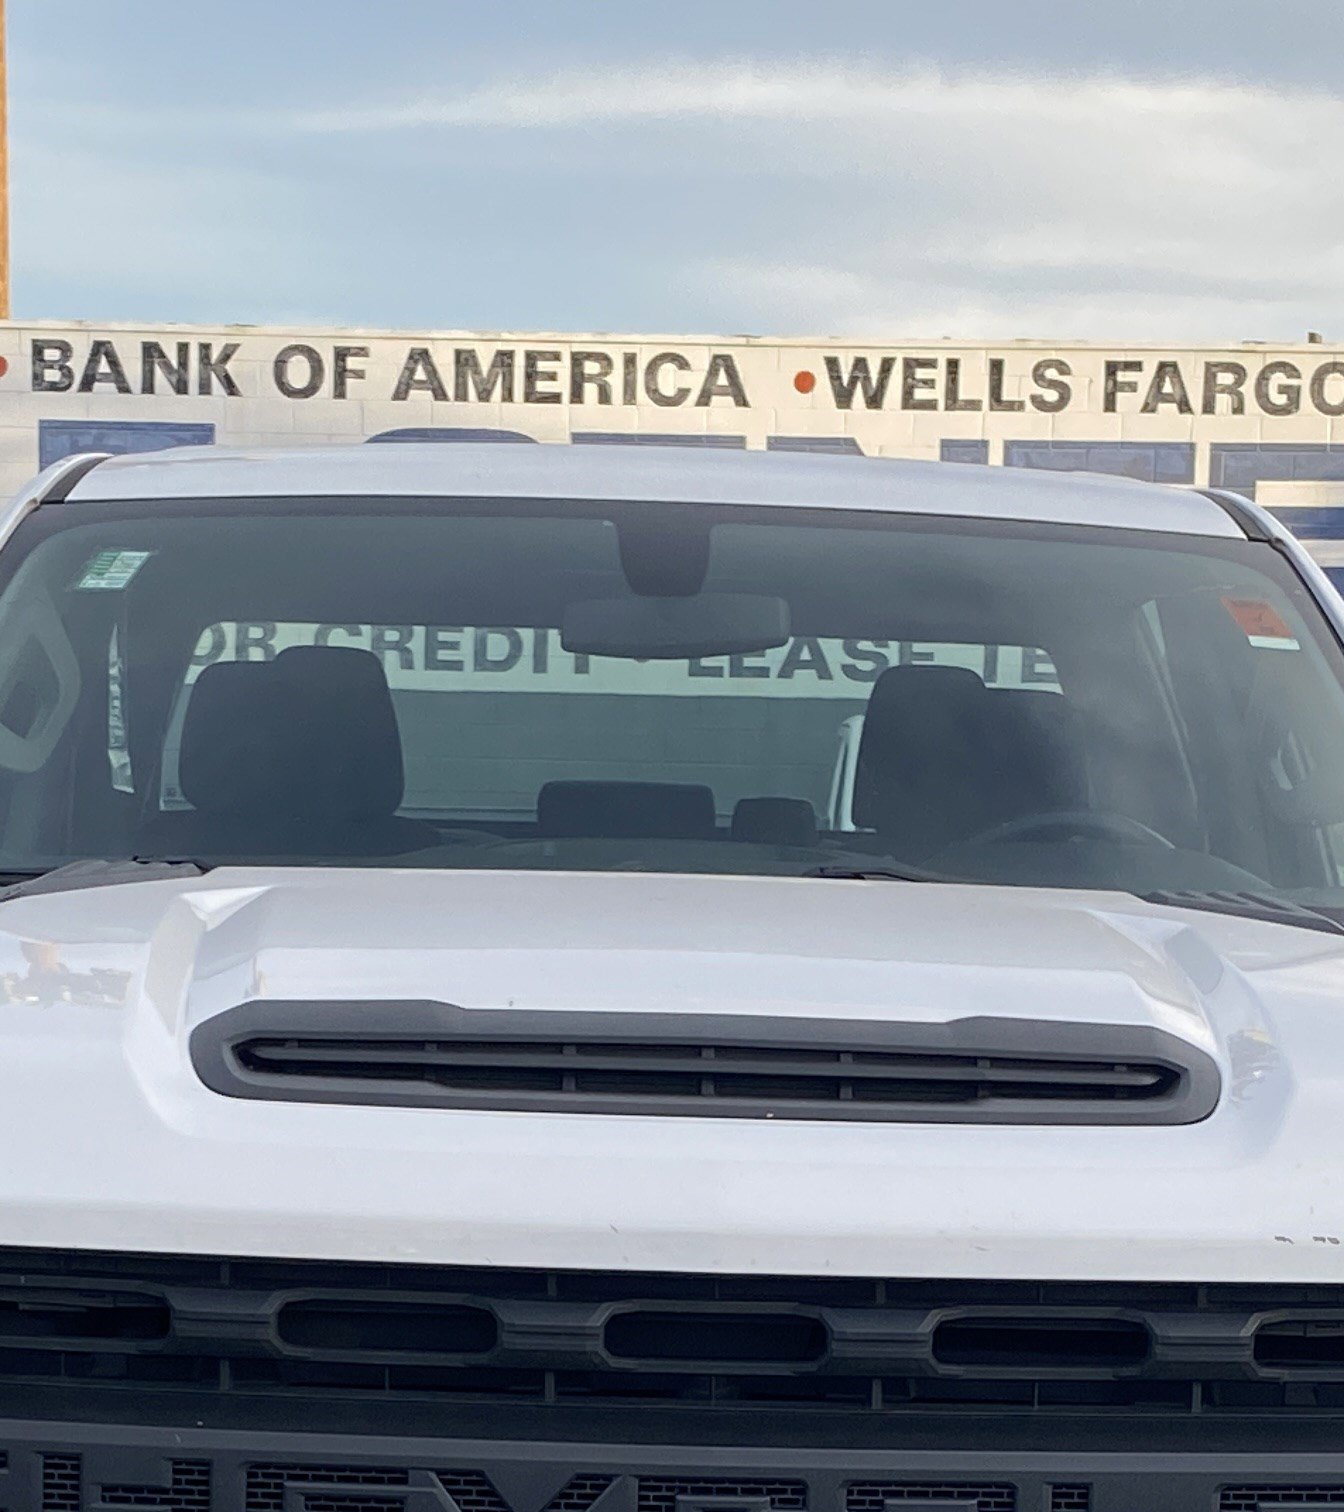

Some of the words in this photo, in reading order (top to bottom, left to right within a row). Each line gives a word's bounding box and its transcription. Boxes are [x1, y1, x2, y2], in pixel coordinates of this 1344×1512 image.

[31, 338, 242, 397] BANK
[273, 345, 369, 400] OF
[391, 347, 750, 408] AMERICA
[824, 356, 1071, 413] WELLS
